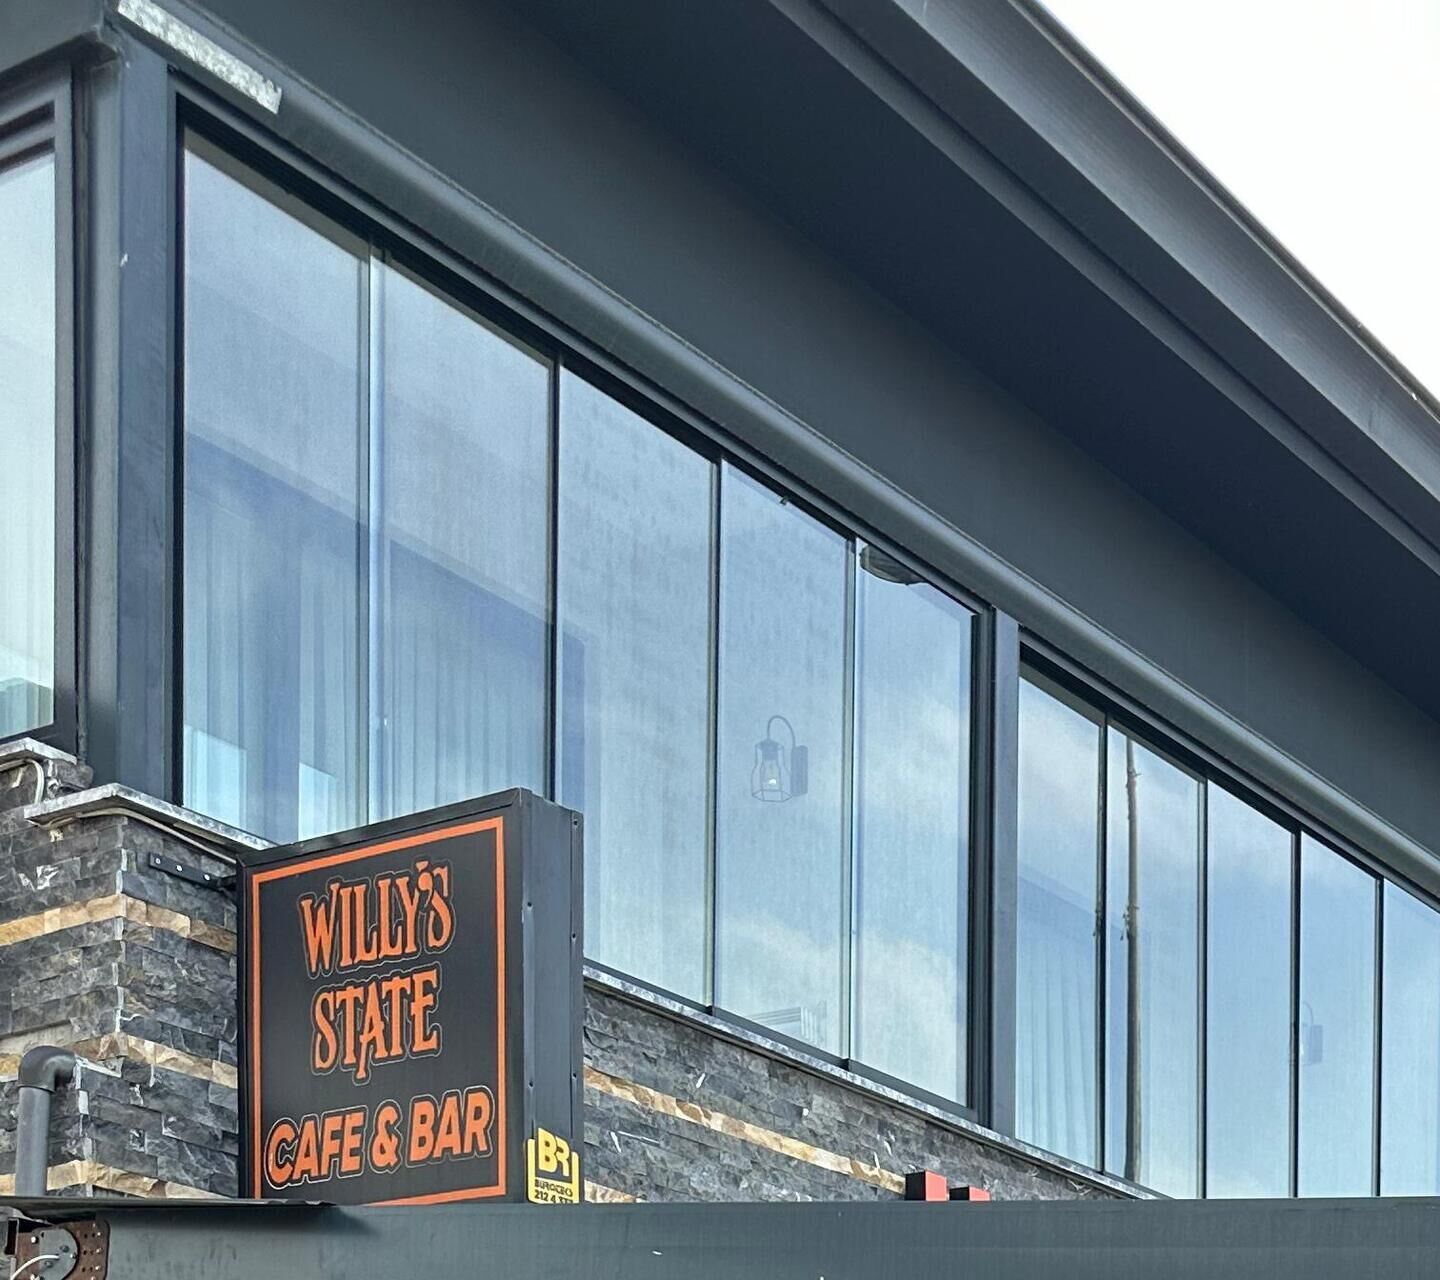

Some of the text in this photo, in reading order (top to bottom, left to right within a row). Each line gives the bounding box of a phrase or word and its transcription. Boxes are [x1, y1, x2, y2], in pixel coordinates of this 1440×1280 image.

[301, 860, 452, 974] WILLY'S
[315, 968, 438, 1080] STATE
[269, 1090, 493, 1184] CAFE & BAR
[537, 1127, 570, 1177] BR
